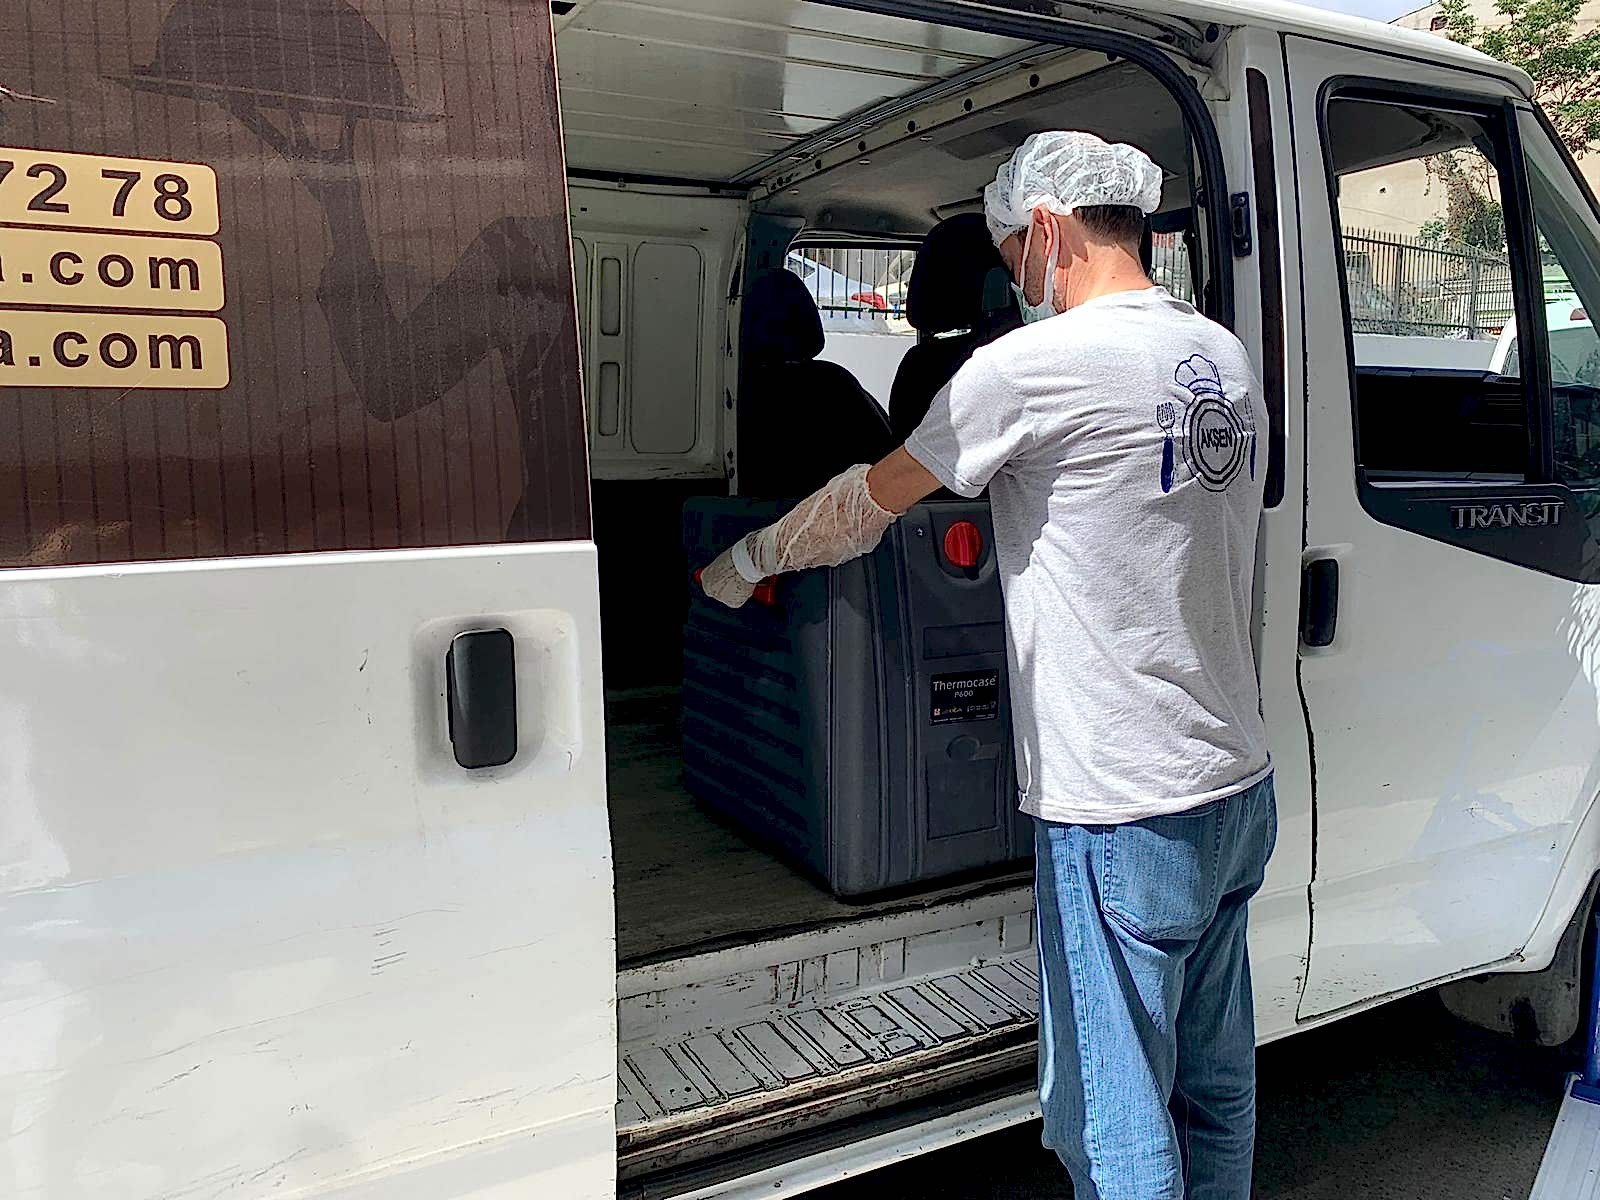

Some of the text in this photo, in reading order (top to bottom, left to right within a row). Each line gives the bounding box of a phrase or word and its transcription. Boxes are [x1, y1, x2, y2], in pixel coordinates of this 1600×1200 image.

[101, 168, 192, 221] 78
[0, 251, 200, 291] .com
[1200, 426, 1233, 453] AKŞEN
[1450, 502, 1565, 529] TRANSIT
[933, 677, 996, 691] Thermocase
[954, 690, 974, 698] P600
